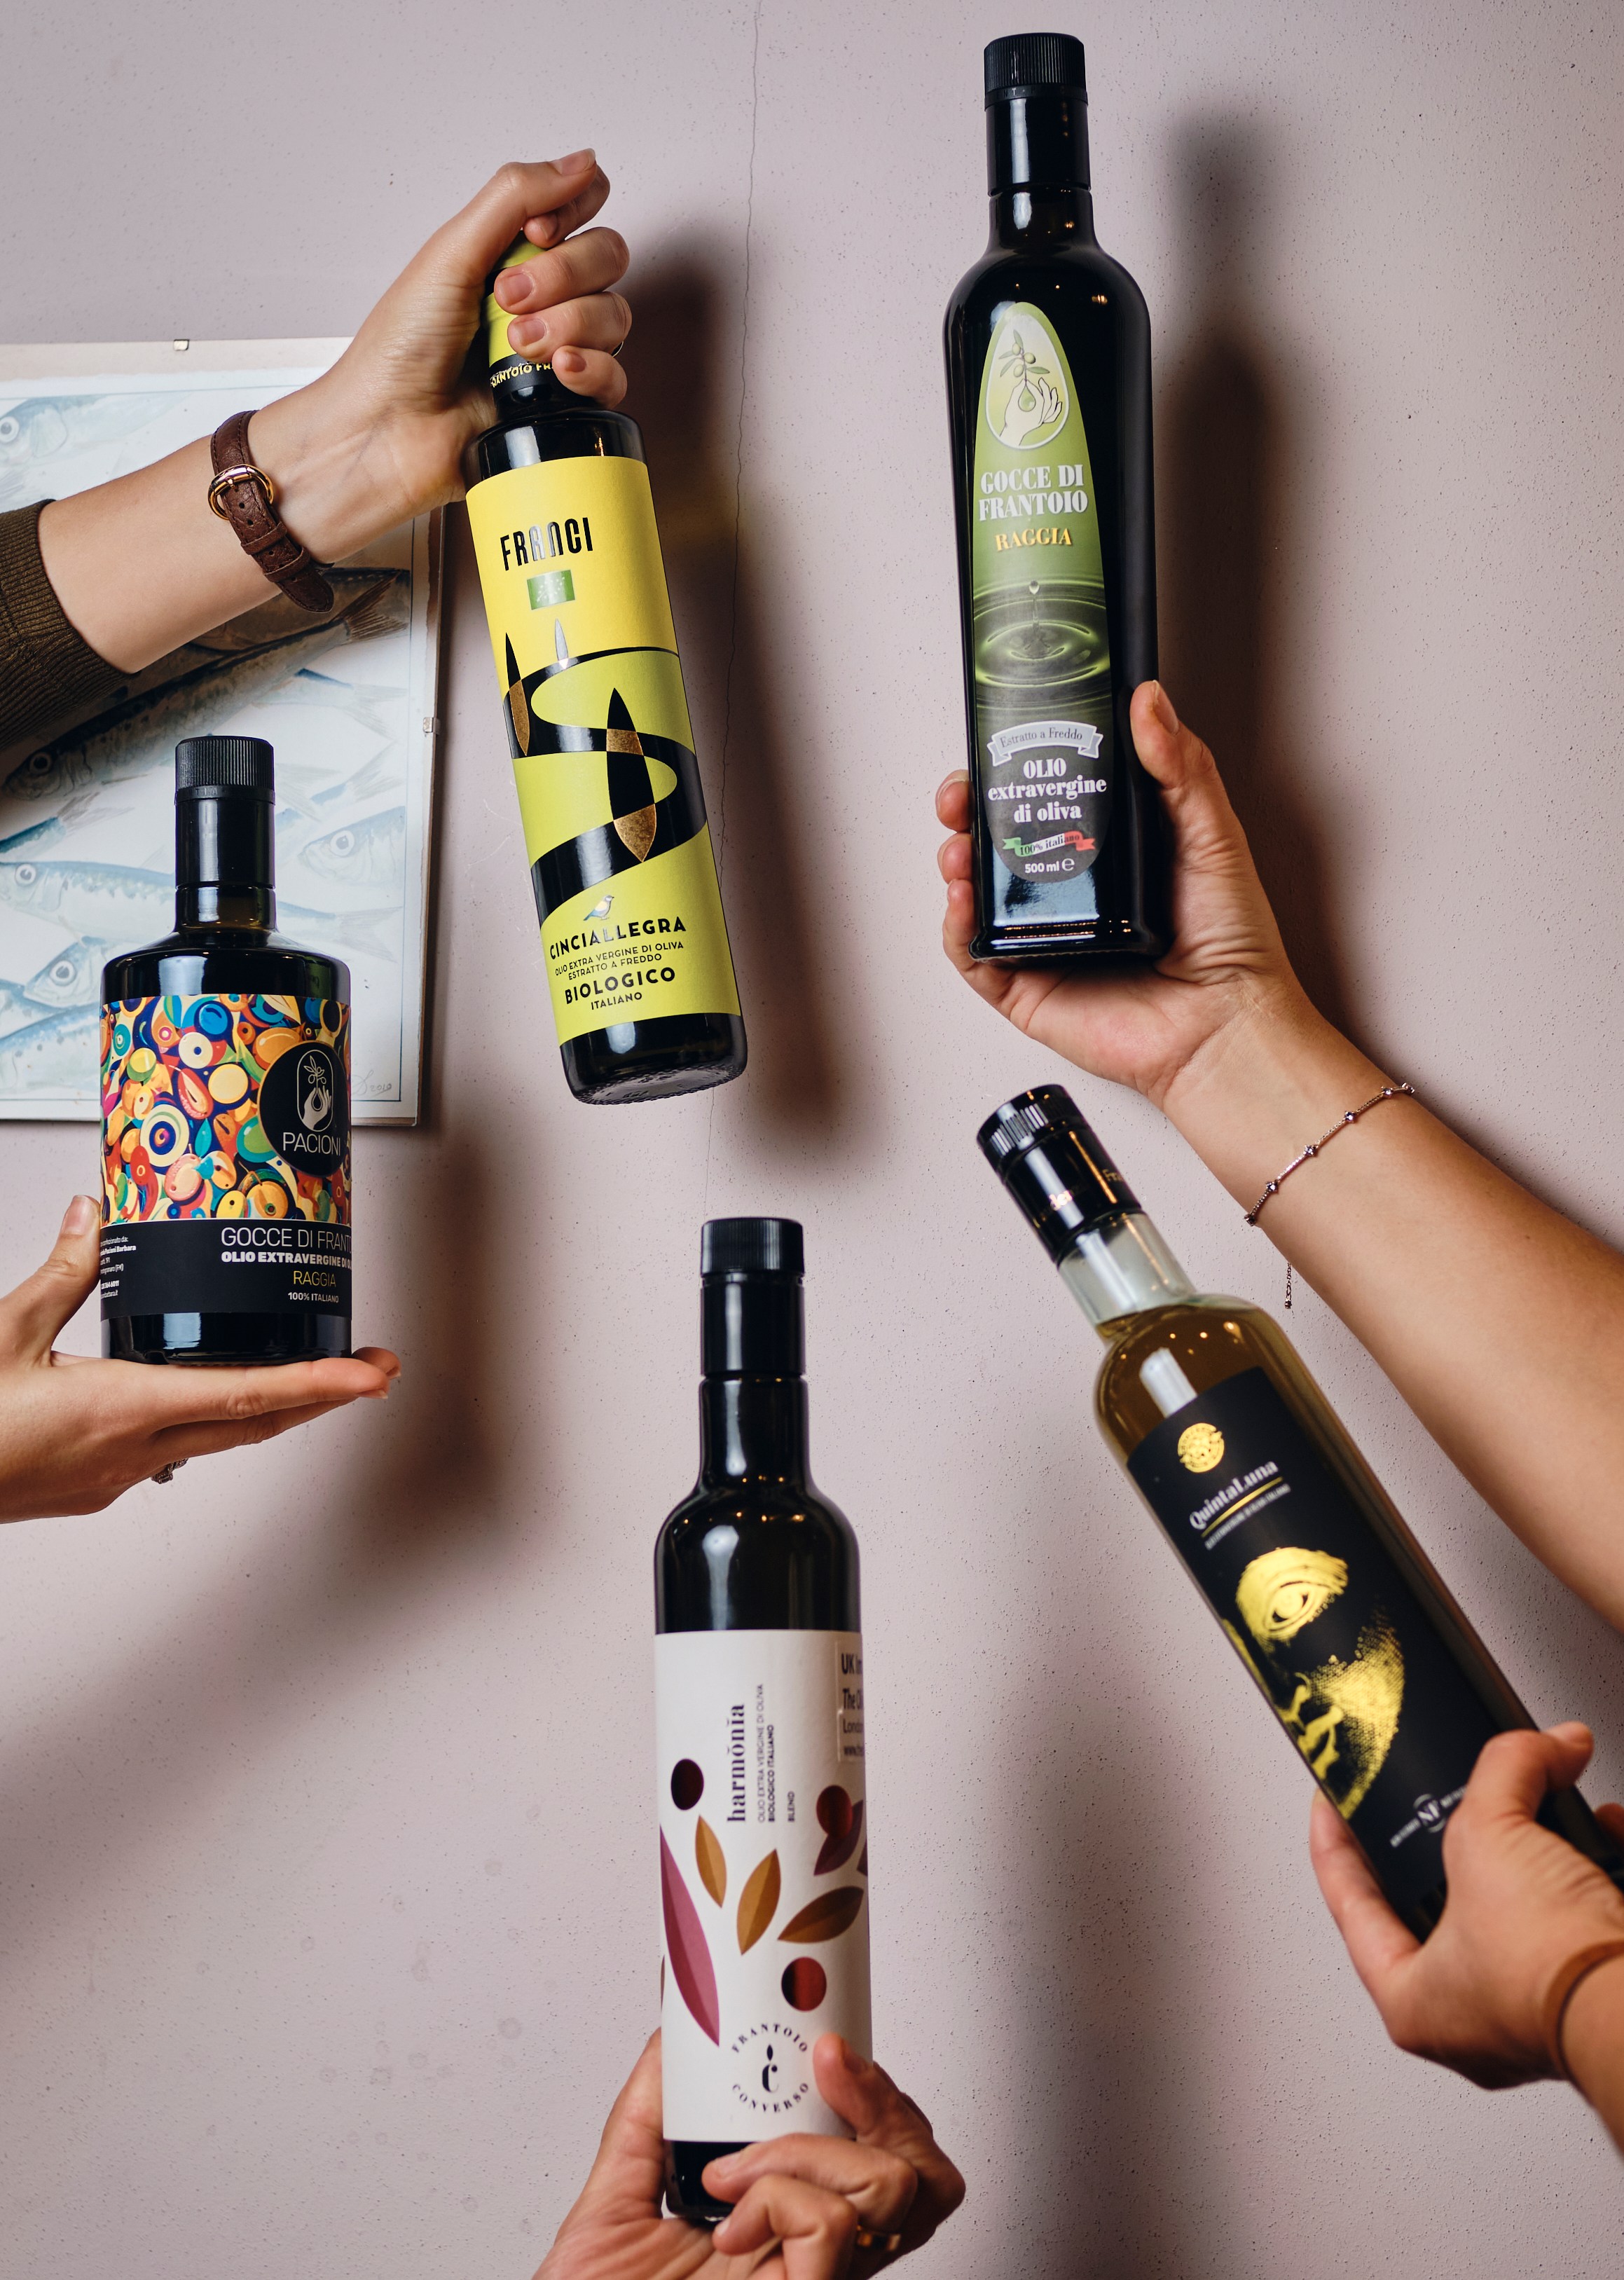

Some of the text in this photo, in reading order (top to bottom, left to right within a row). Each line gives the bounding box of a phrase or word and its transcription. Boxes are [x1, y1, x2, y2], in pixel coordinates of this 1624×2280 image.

[981, 465, 1084, 494] GOCCE DI
[979, 490, 1088, 521] FRANTOIO
[500, 517, 593, 571] FRANCI
[995, 528, 1072, 551] RAGGIA
[1000, 730, 1037, 748] Estratto
[1049, 727, 1082, 740] Freddo
[1024, 757, 1066, 778] OLIO
[988, 774, 1107, 800] extravergine
[1014, 801, 1082, 823] di oliva
[1019, 841, 1042, 855] 100%
[1025, 863, 1045, 873] 500
[1047, 861, 1059, 872] ml
[550, 916, 686, 959] CINCIALLEGRA
[555, 964, 567, 976] OLIO
[570, 956, 593, 970] EXTRA
[596, 947, 638, 961] VERGINE
[655, 941, 684, 950] OLIVA
[568, 963, 607, 980] ESTRATTO
[621, 954, 662, 966] FREDDO
[565, 967, 675, 1004] BIOLOGICO
[591, 992, 642, 1010] ITALIANO
[283, 1132, 340, 1156] PACIONI
[221, 1227, 293, 1247] GOCCE
[298, 1229, 312, 1248] DI
[221, 1251, 256, 1262] OLIO
[258, 1252, 340, 1267] EXTRAVERGINE
[293, 1270, 336, 1287] RAGGIA
[288, 1292, 339, 1303] 100% ITALIANO
[1190, 1461, 1279, 1530] QuintaLuna
[757, 1715, 764, 1724] DI
[731, 2023, 808, 2053] FRANTOIO
[732, 2083, 808, 2113] CONVERSO
